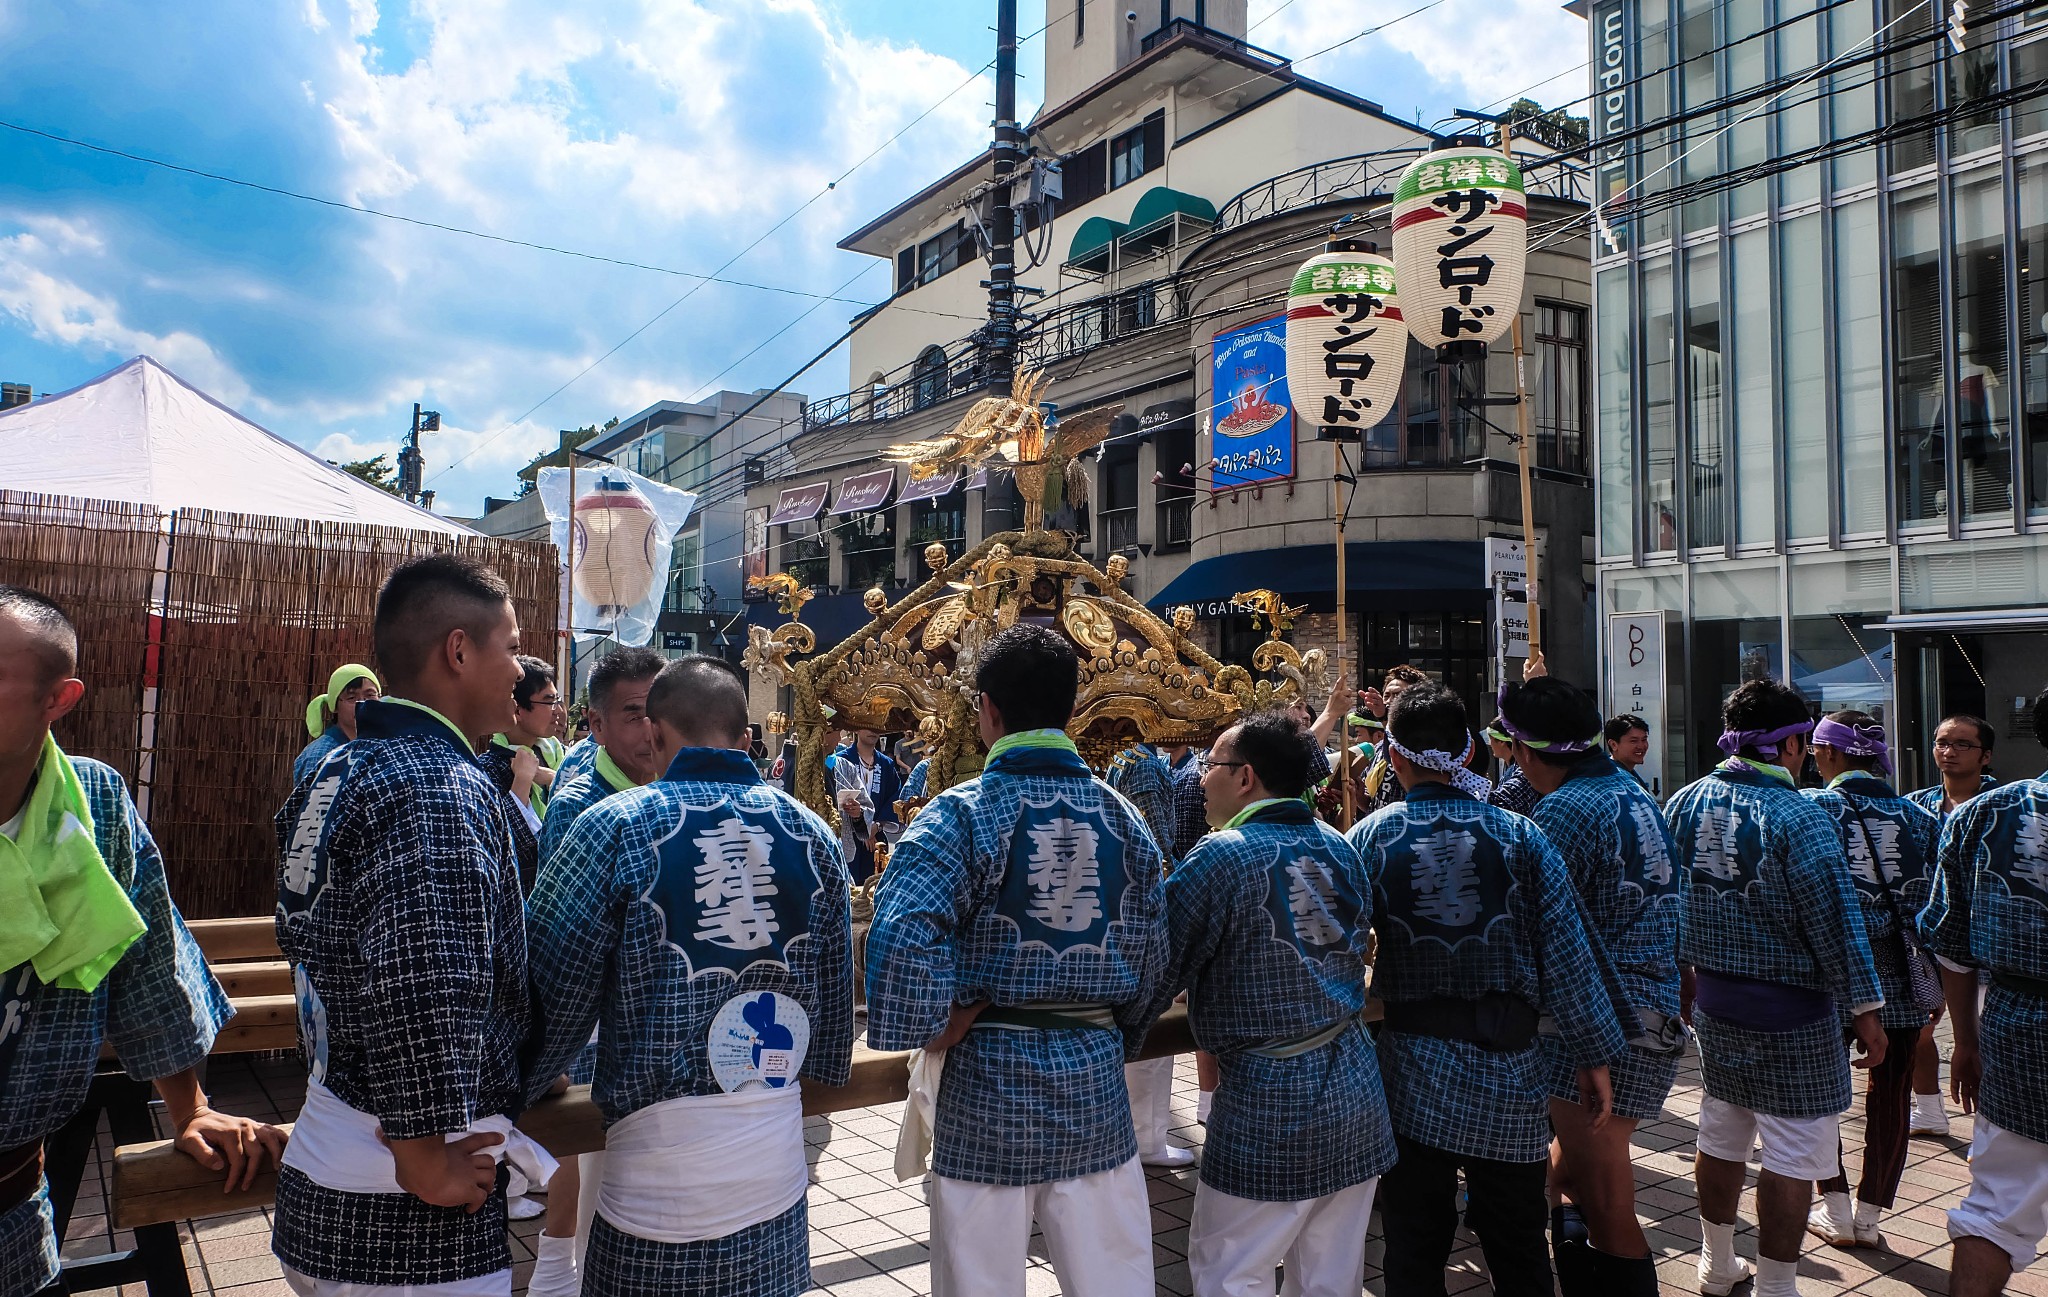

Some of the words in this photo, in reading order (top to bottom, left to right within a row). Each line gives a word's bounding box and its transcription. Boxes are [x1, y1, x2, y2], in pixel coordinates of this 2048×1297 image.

[1600, 9, 1625, 172] kingdom
[1418, 158, 1510, 191] 吉祥寺
[1431, 188, 1499, 338] サンロード
[1312, 265, 1395, 290] 吉祥寺
[1243, 346, 1258, 359] and
[1263, 331, 1286, 351] Viande
[1322, 293, 1383, 424] サンロード
[1235, 362, 1267, 381] Pasta
[1494, 551, 1514, 560] PEARLY
[1208, 600, 1254, 616] GATES
[1631, 684, 1644, 712] 白山
